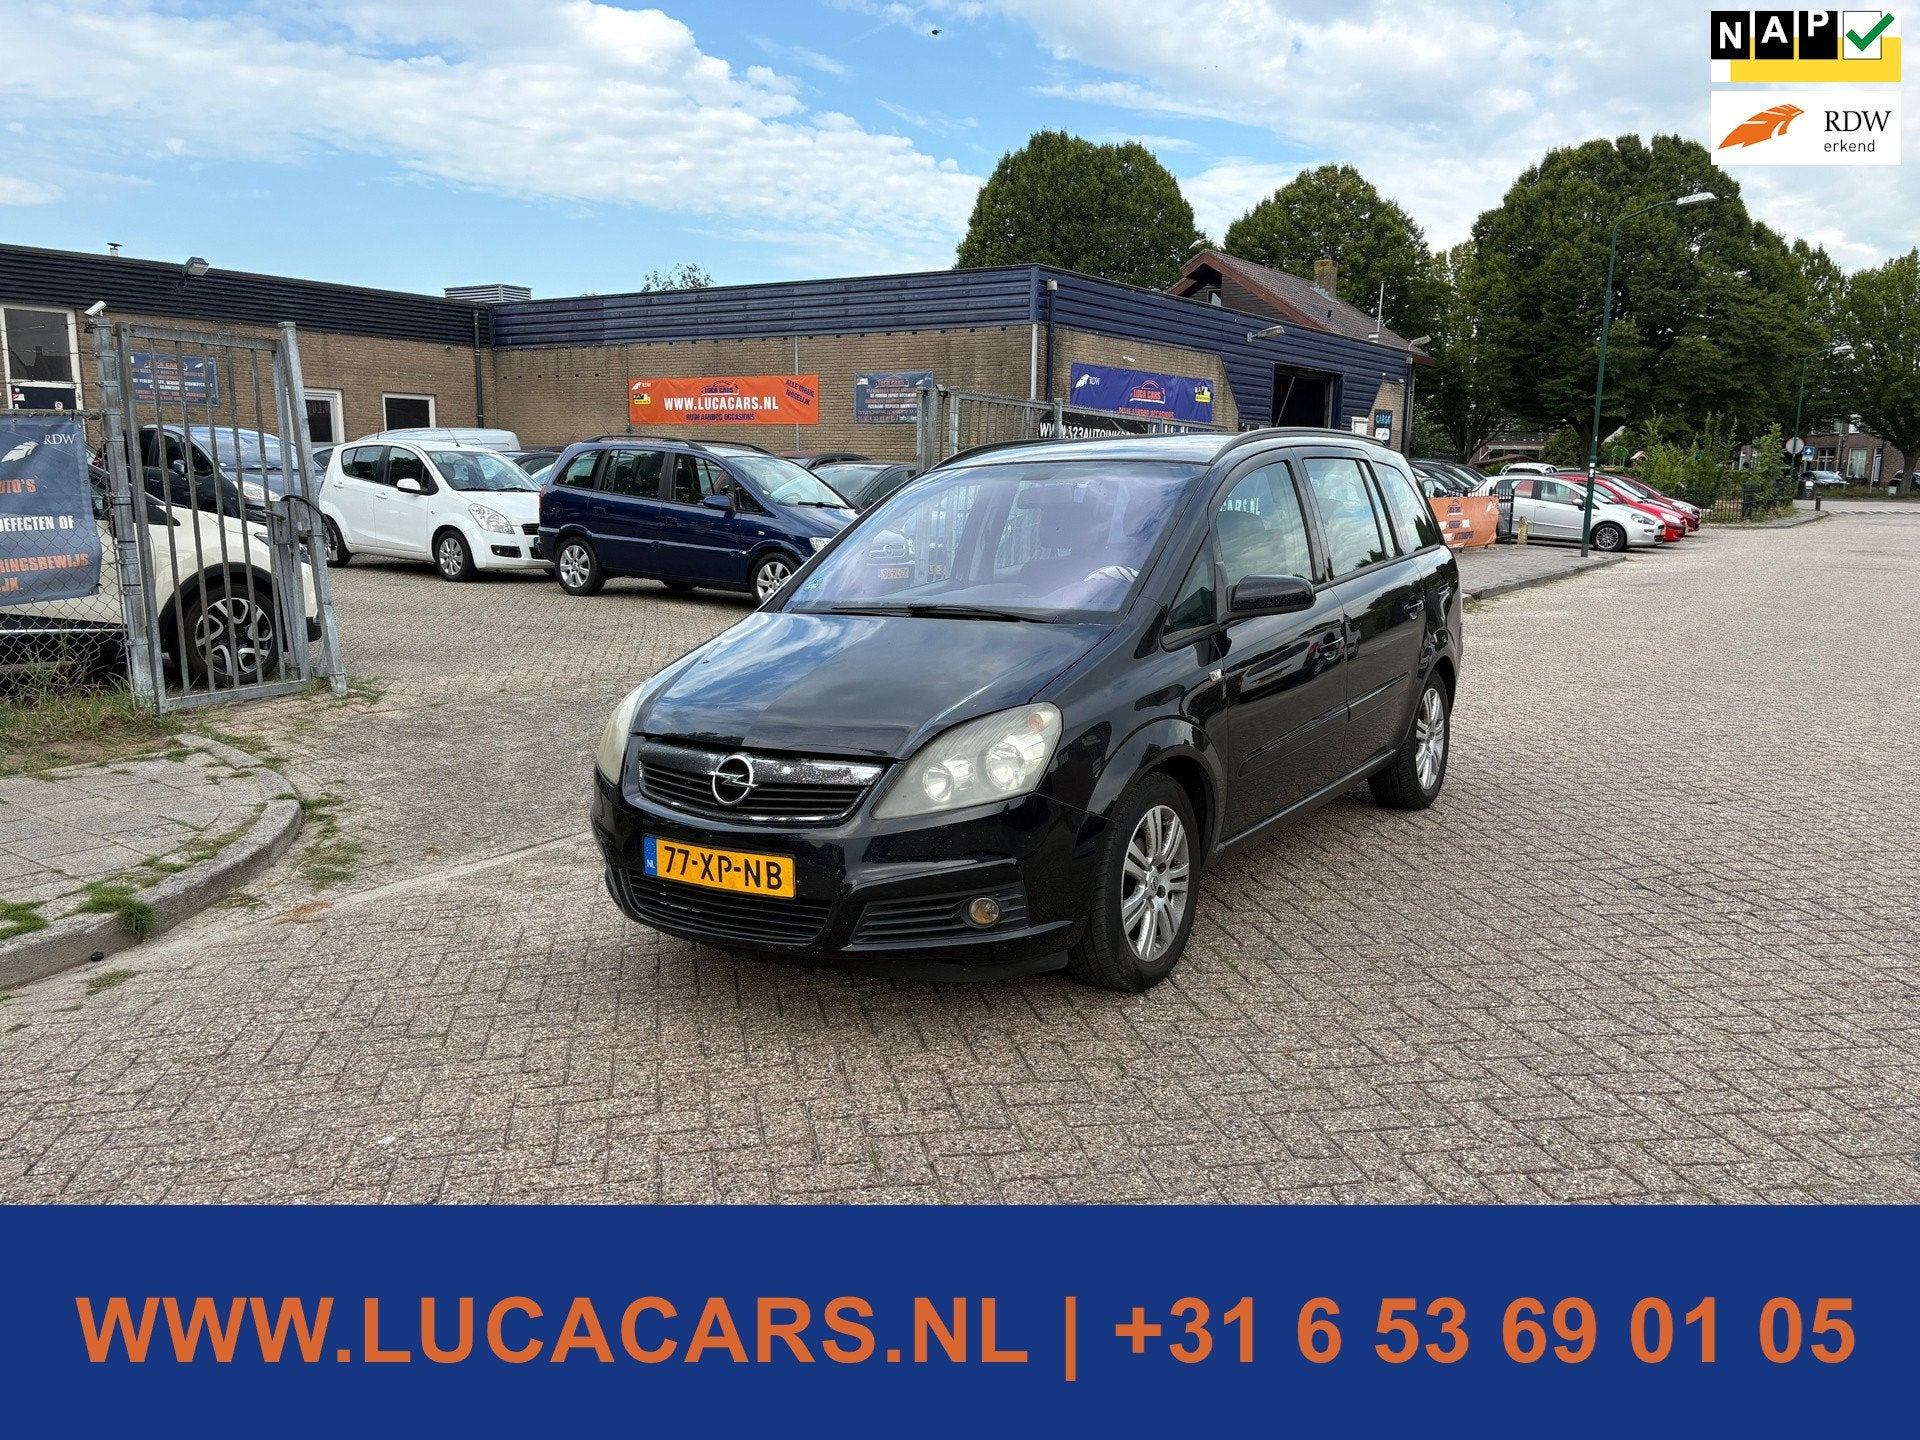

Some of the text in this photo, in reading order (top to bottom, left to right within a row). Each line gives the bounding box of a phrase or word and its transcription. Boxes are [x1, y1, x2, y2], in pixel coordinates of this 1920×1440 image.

[663, 396, 779, 411] WWW.LUCACARS.NL
[723, 413, 755, 421] OCCASIONS
[43, 433, 76, 445] RDW
[59, 515, 74, 530] OF
[646, 859, 656, 869] NL
[664, 845, 783, 890] 77-XP-NB
